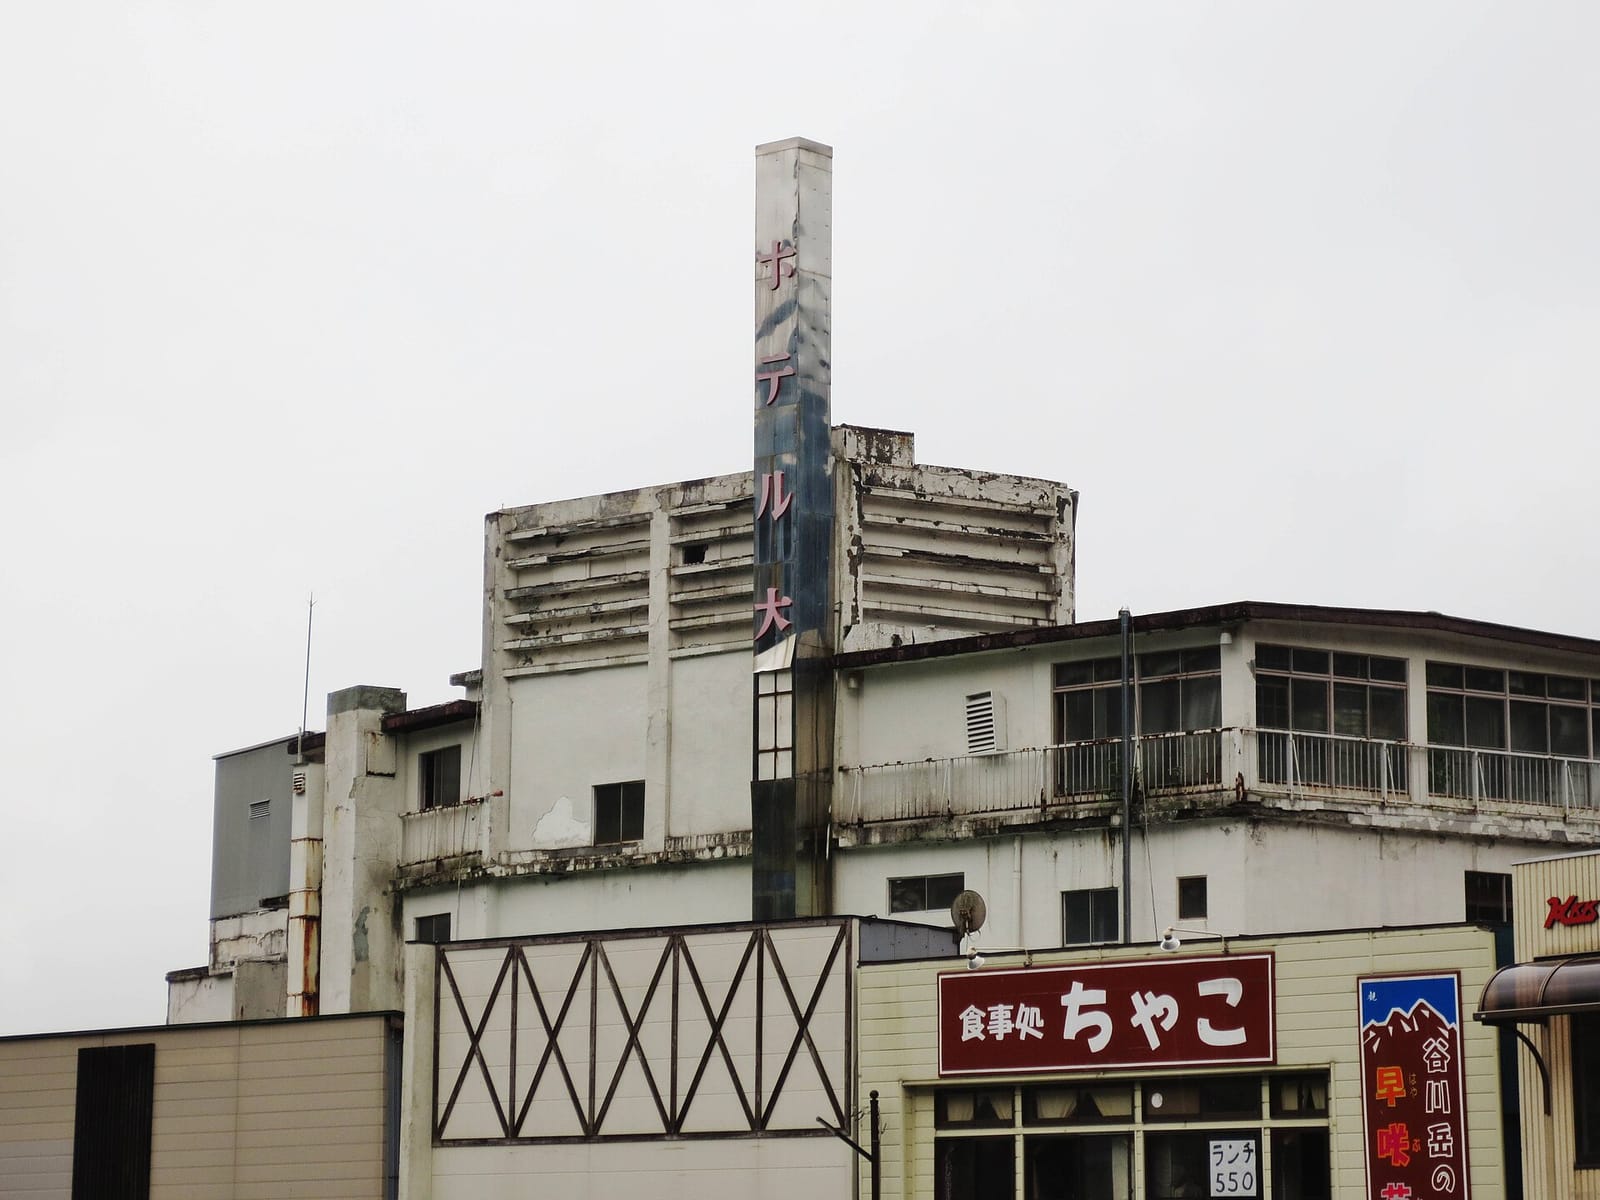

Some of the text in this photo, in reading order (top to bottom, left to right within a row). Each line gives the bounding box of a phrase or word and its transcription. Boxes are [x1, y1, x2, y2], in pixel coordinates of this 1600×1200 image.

[959, 1003, 1044, 1042] 食事処
[1422, 1037, 1455, 1193] 谷川岳の
[1213, 1142, 1254, 1167] ランチ
[1216, 1171, 1253, 1192] 550
